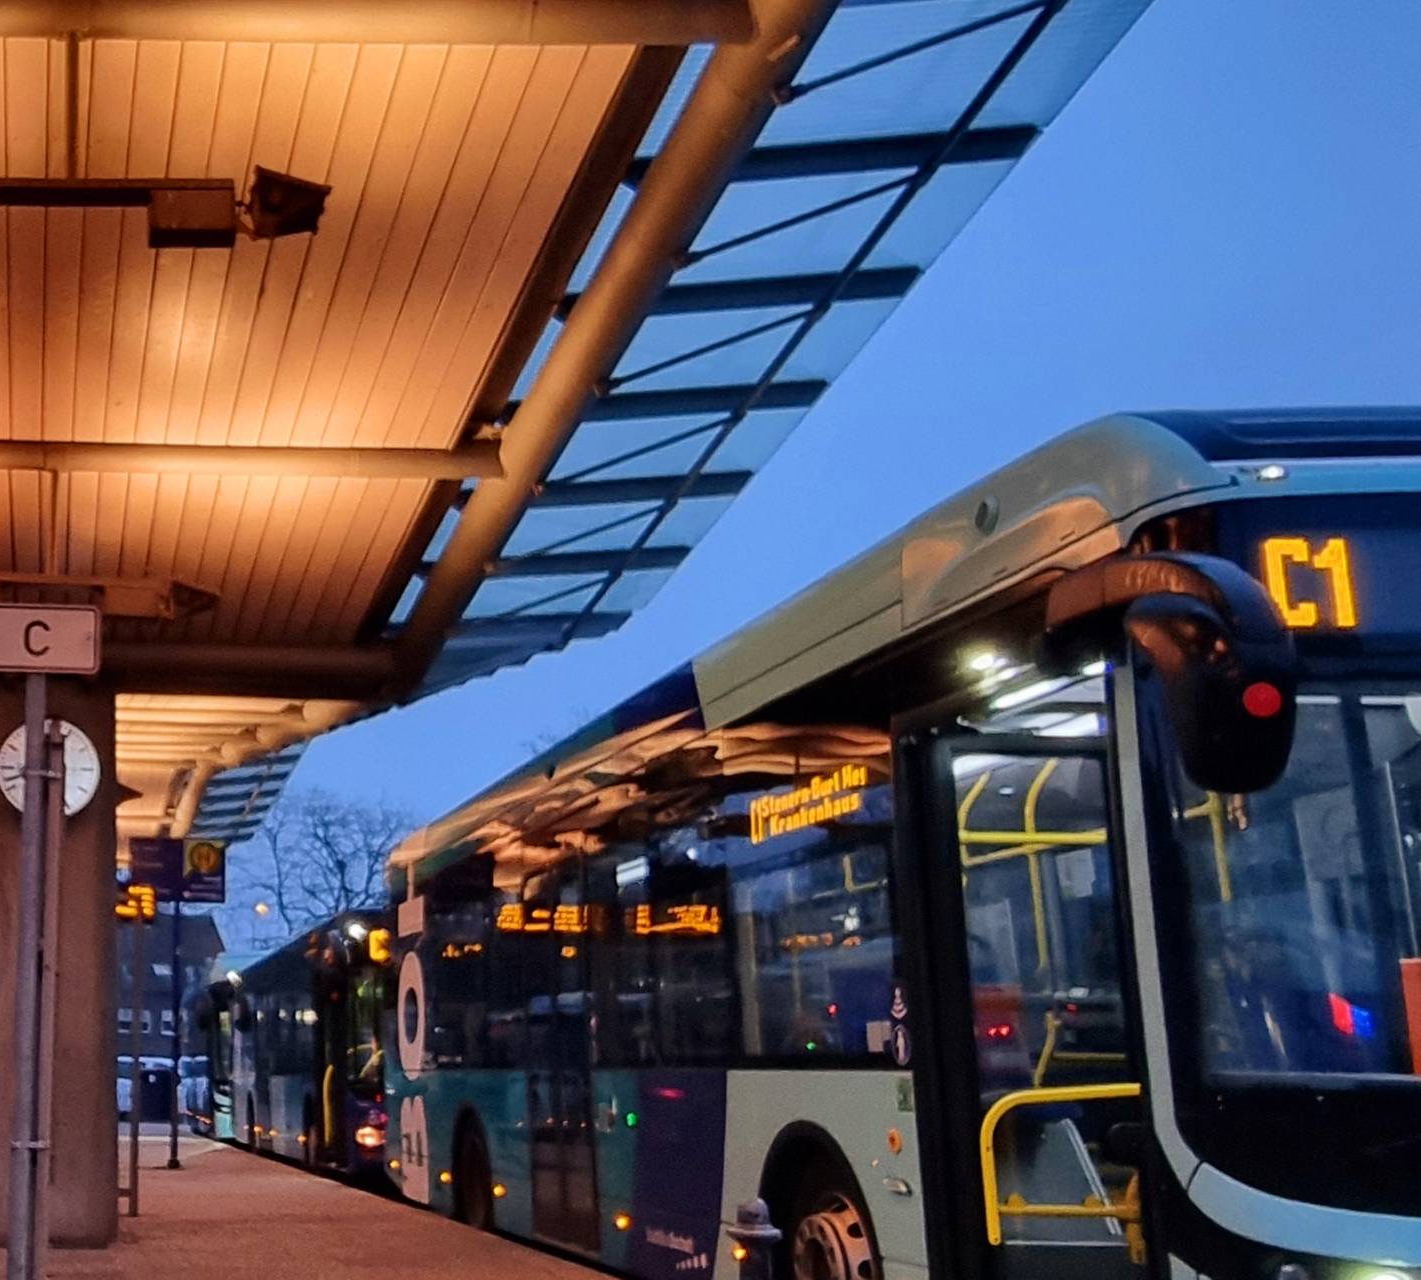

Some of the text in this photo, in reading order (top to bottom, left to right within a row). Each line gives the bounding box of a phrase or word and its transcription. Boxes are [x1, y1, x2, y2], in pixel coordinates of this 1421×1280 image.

[1263, 537, 1357, 628] C1
[24, 620, 50, 657] C
[769, 792, 860, 837] Krankenhaus
